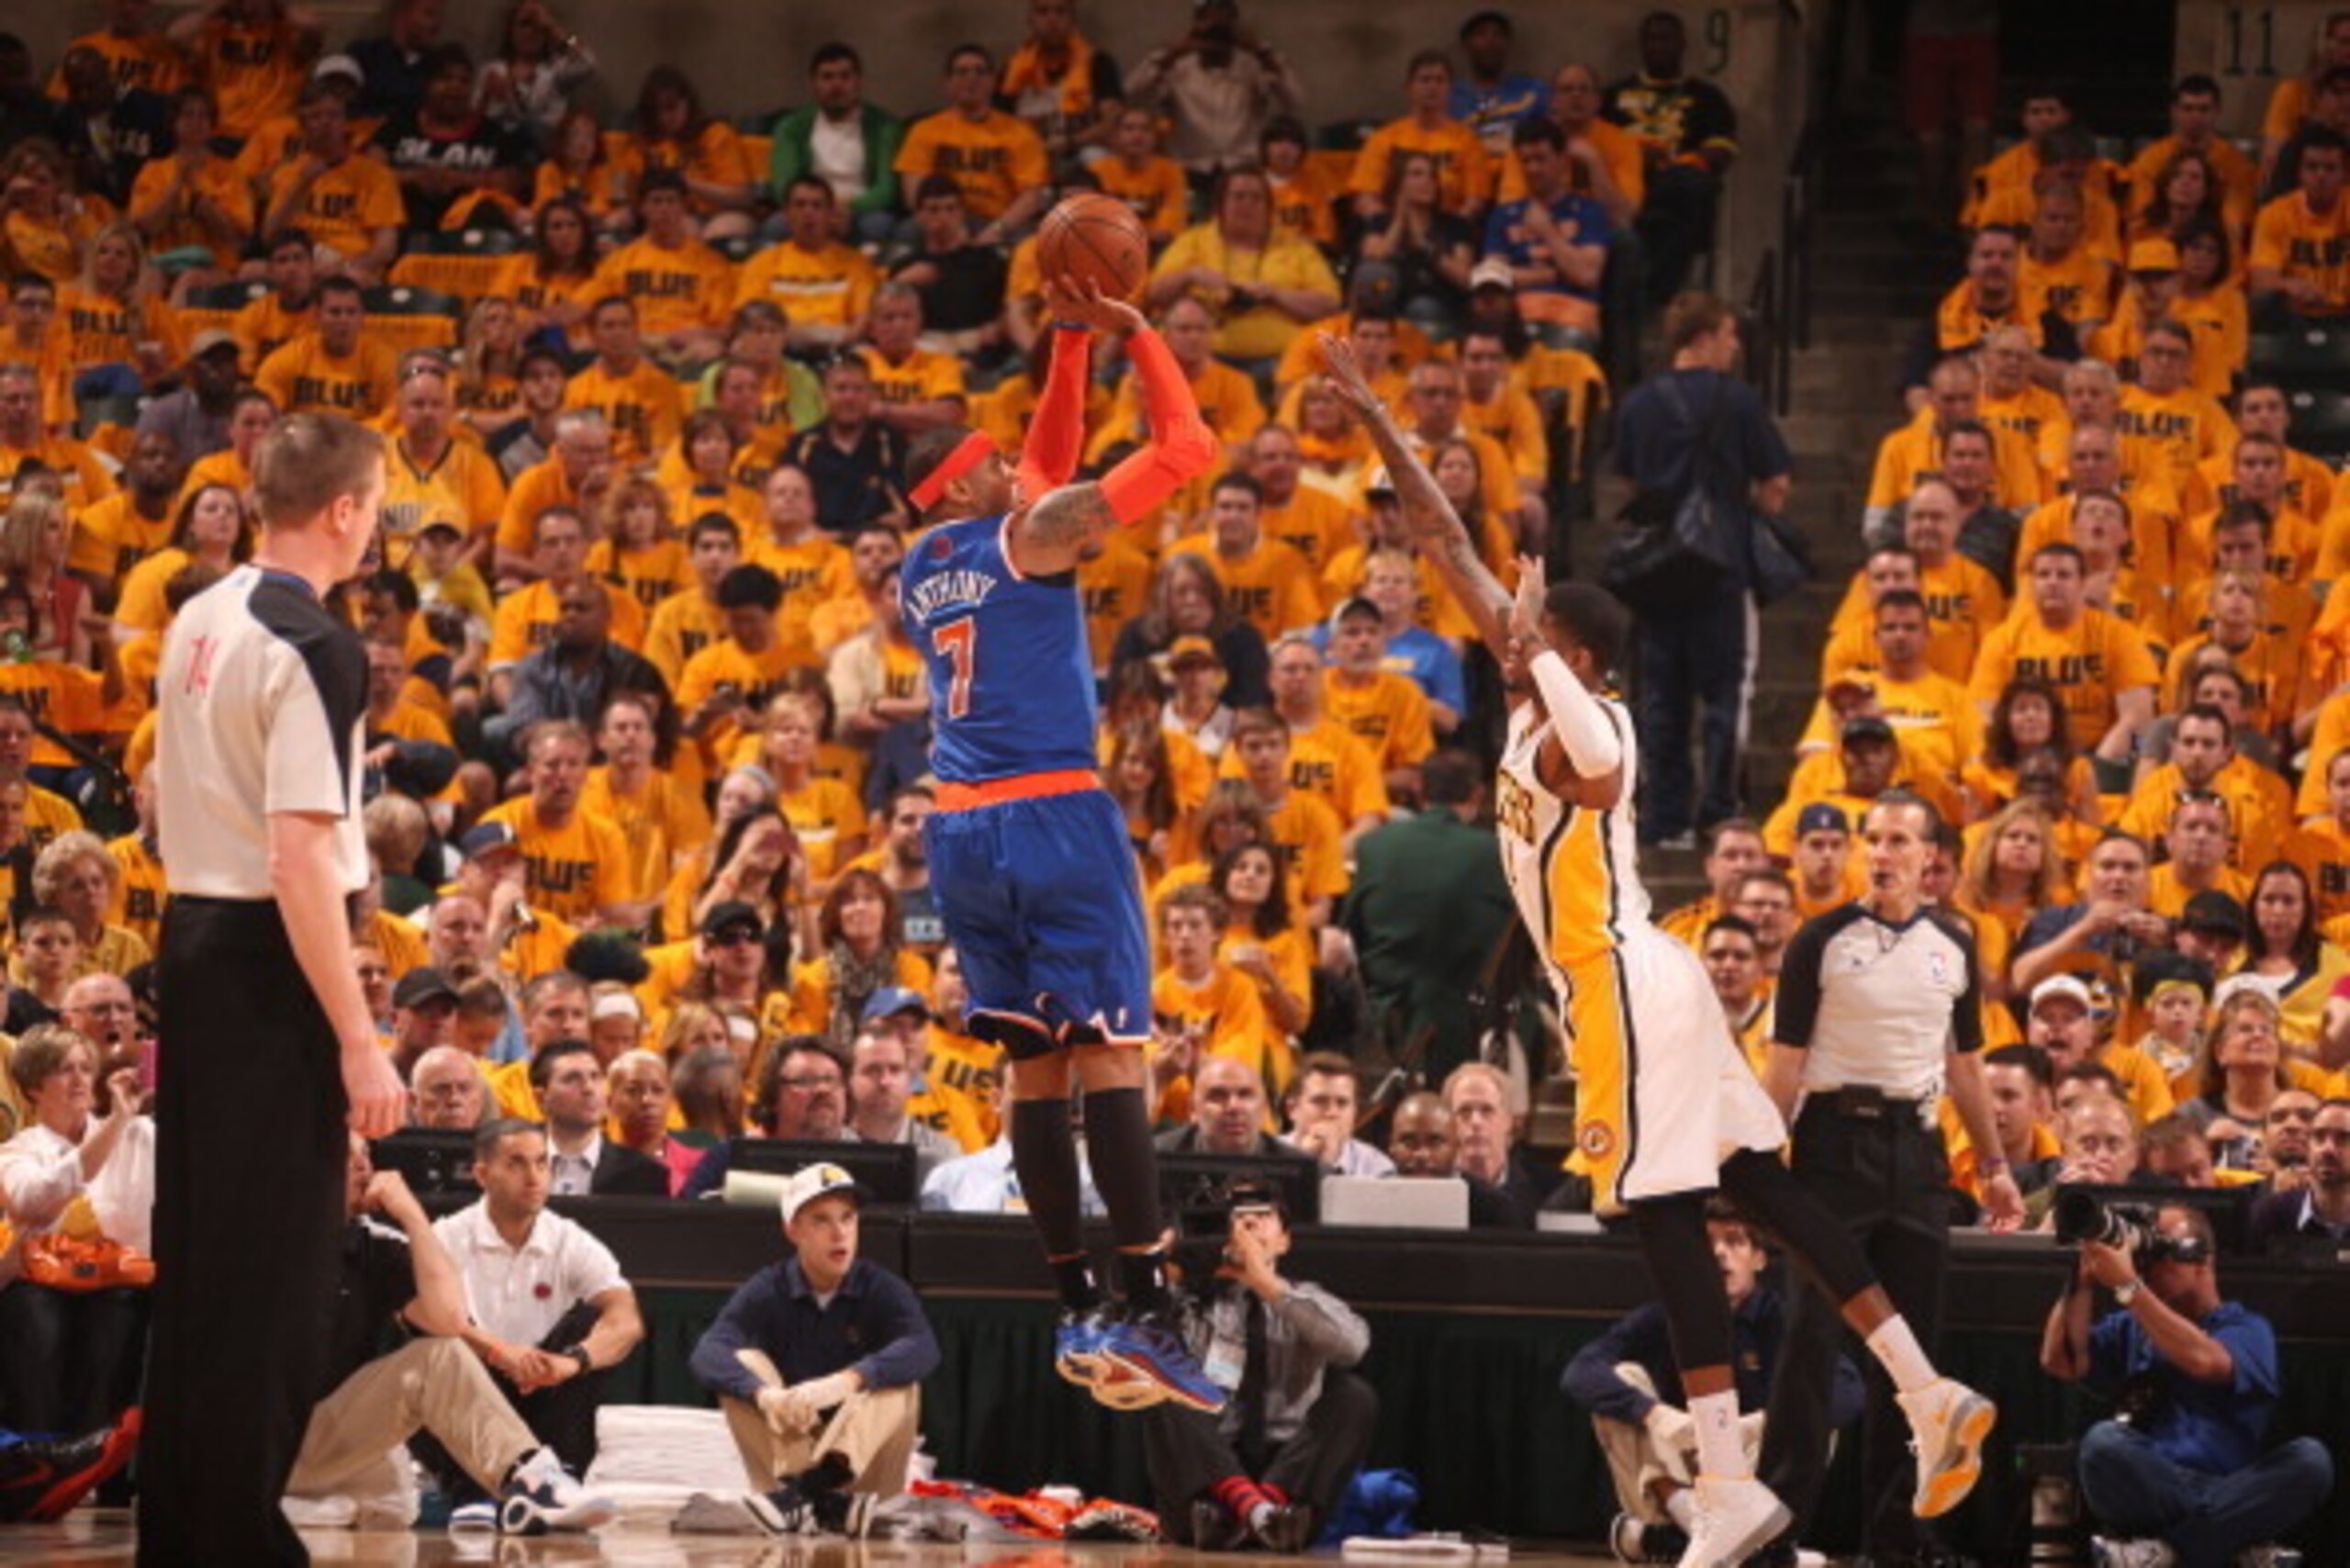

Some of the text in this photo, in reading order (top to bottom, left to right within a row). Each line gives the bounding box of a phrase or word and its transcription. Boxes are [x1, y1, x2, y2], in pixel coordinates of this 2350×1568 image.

[1705, 7, 1730, 74] 9
[2223, 8, 2278, 77] 11
[2111, 410, 2195, 442] BLUE
[1227, 587, 1273, 621] UE
[1928, 594, 1973, 622] UE
[932, 615, 976, 721] 7
[2015, 653, 2105, 687] BLUE
[1292, 761, 1335, 792] UE
